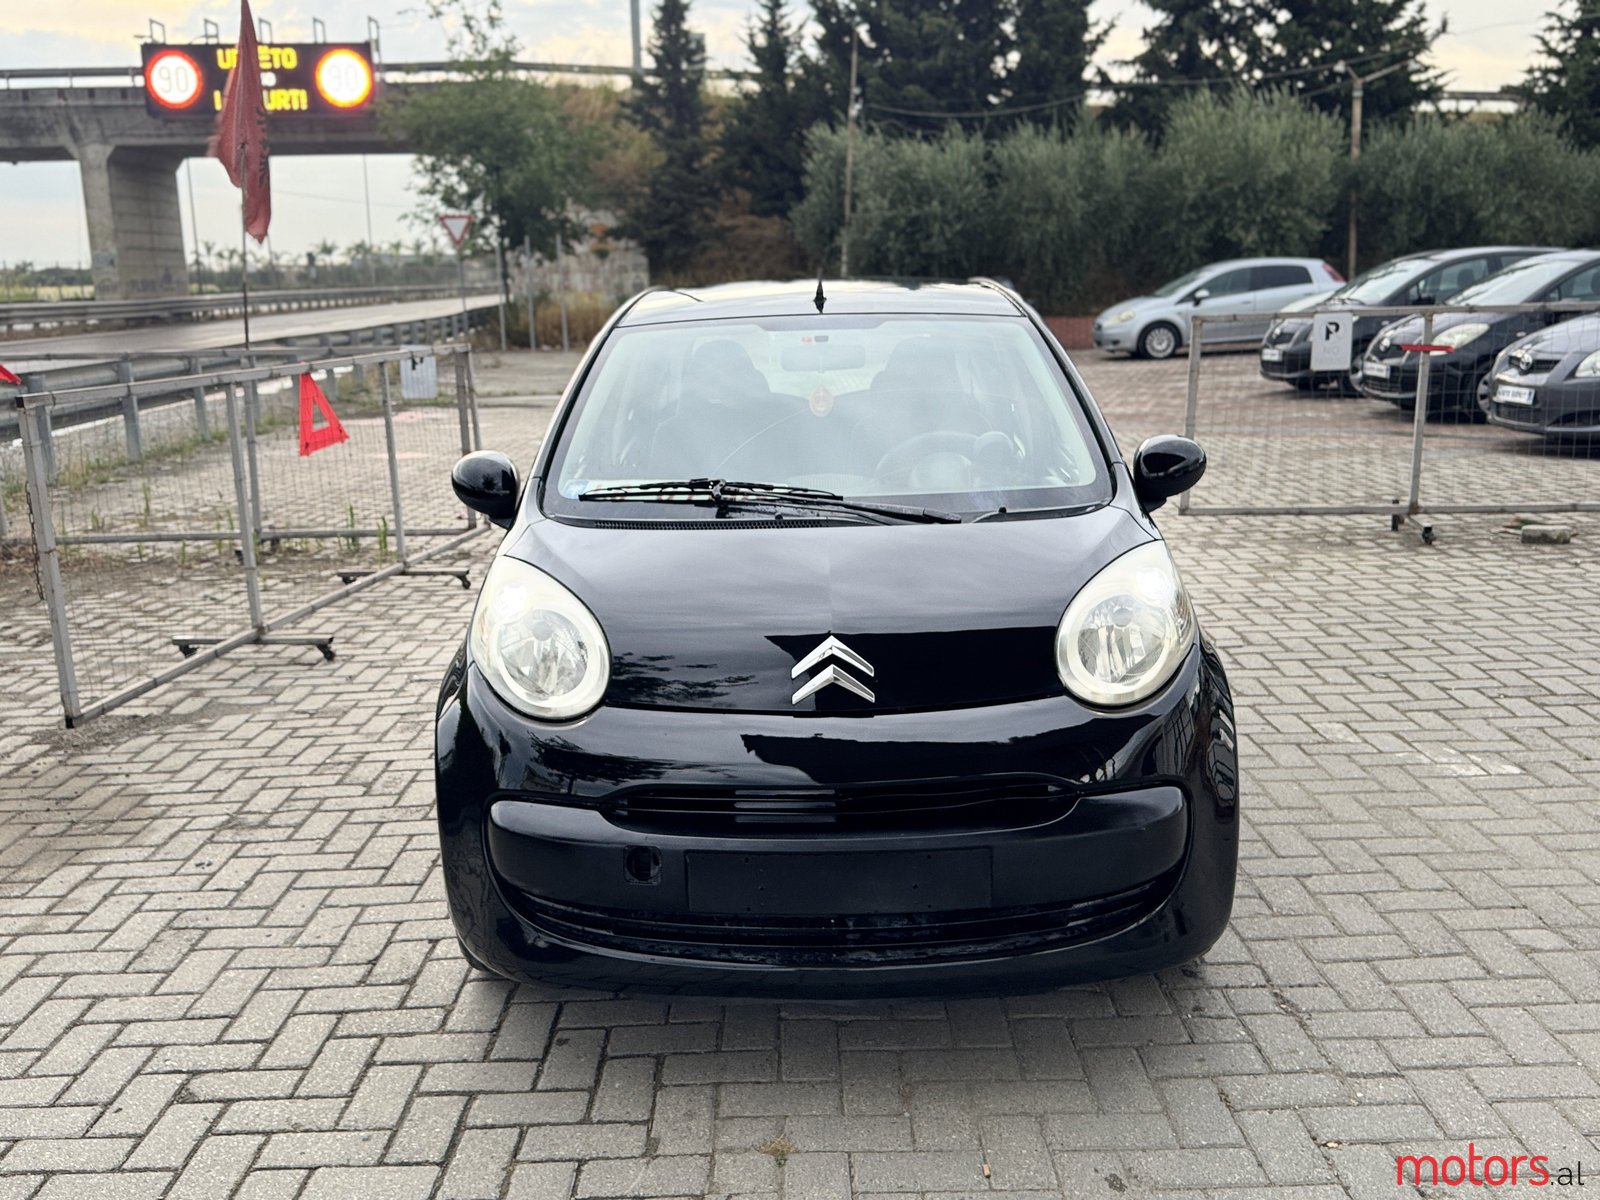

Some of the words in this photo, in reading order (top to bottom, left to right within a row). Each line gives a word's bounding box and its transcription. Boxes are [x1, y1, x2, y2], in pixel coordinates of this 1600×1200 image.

[158, 65, 190, 94] 90
[327, 64, 359, 93] 90
[1324, 321, 1340, 341] P
